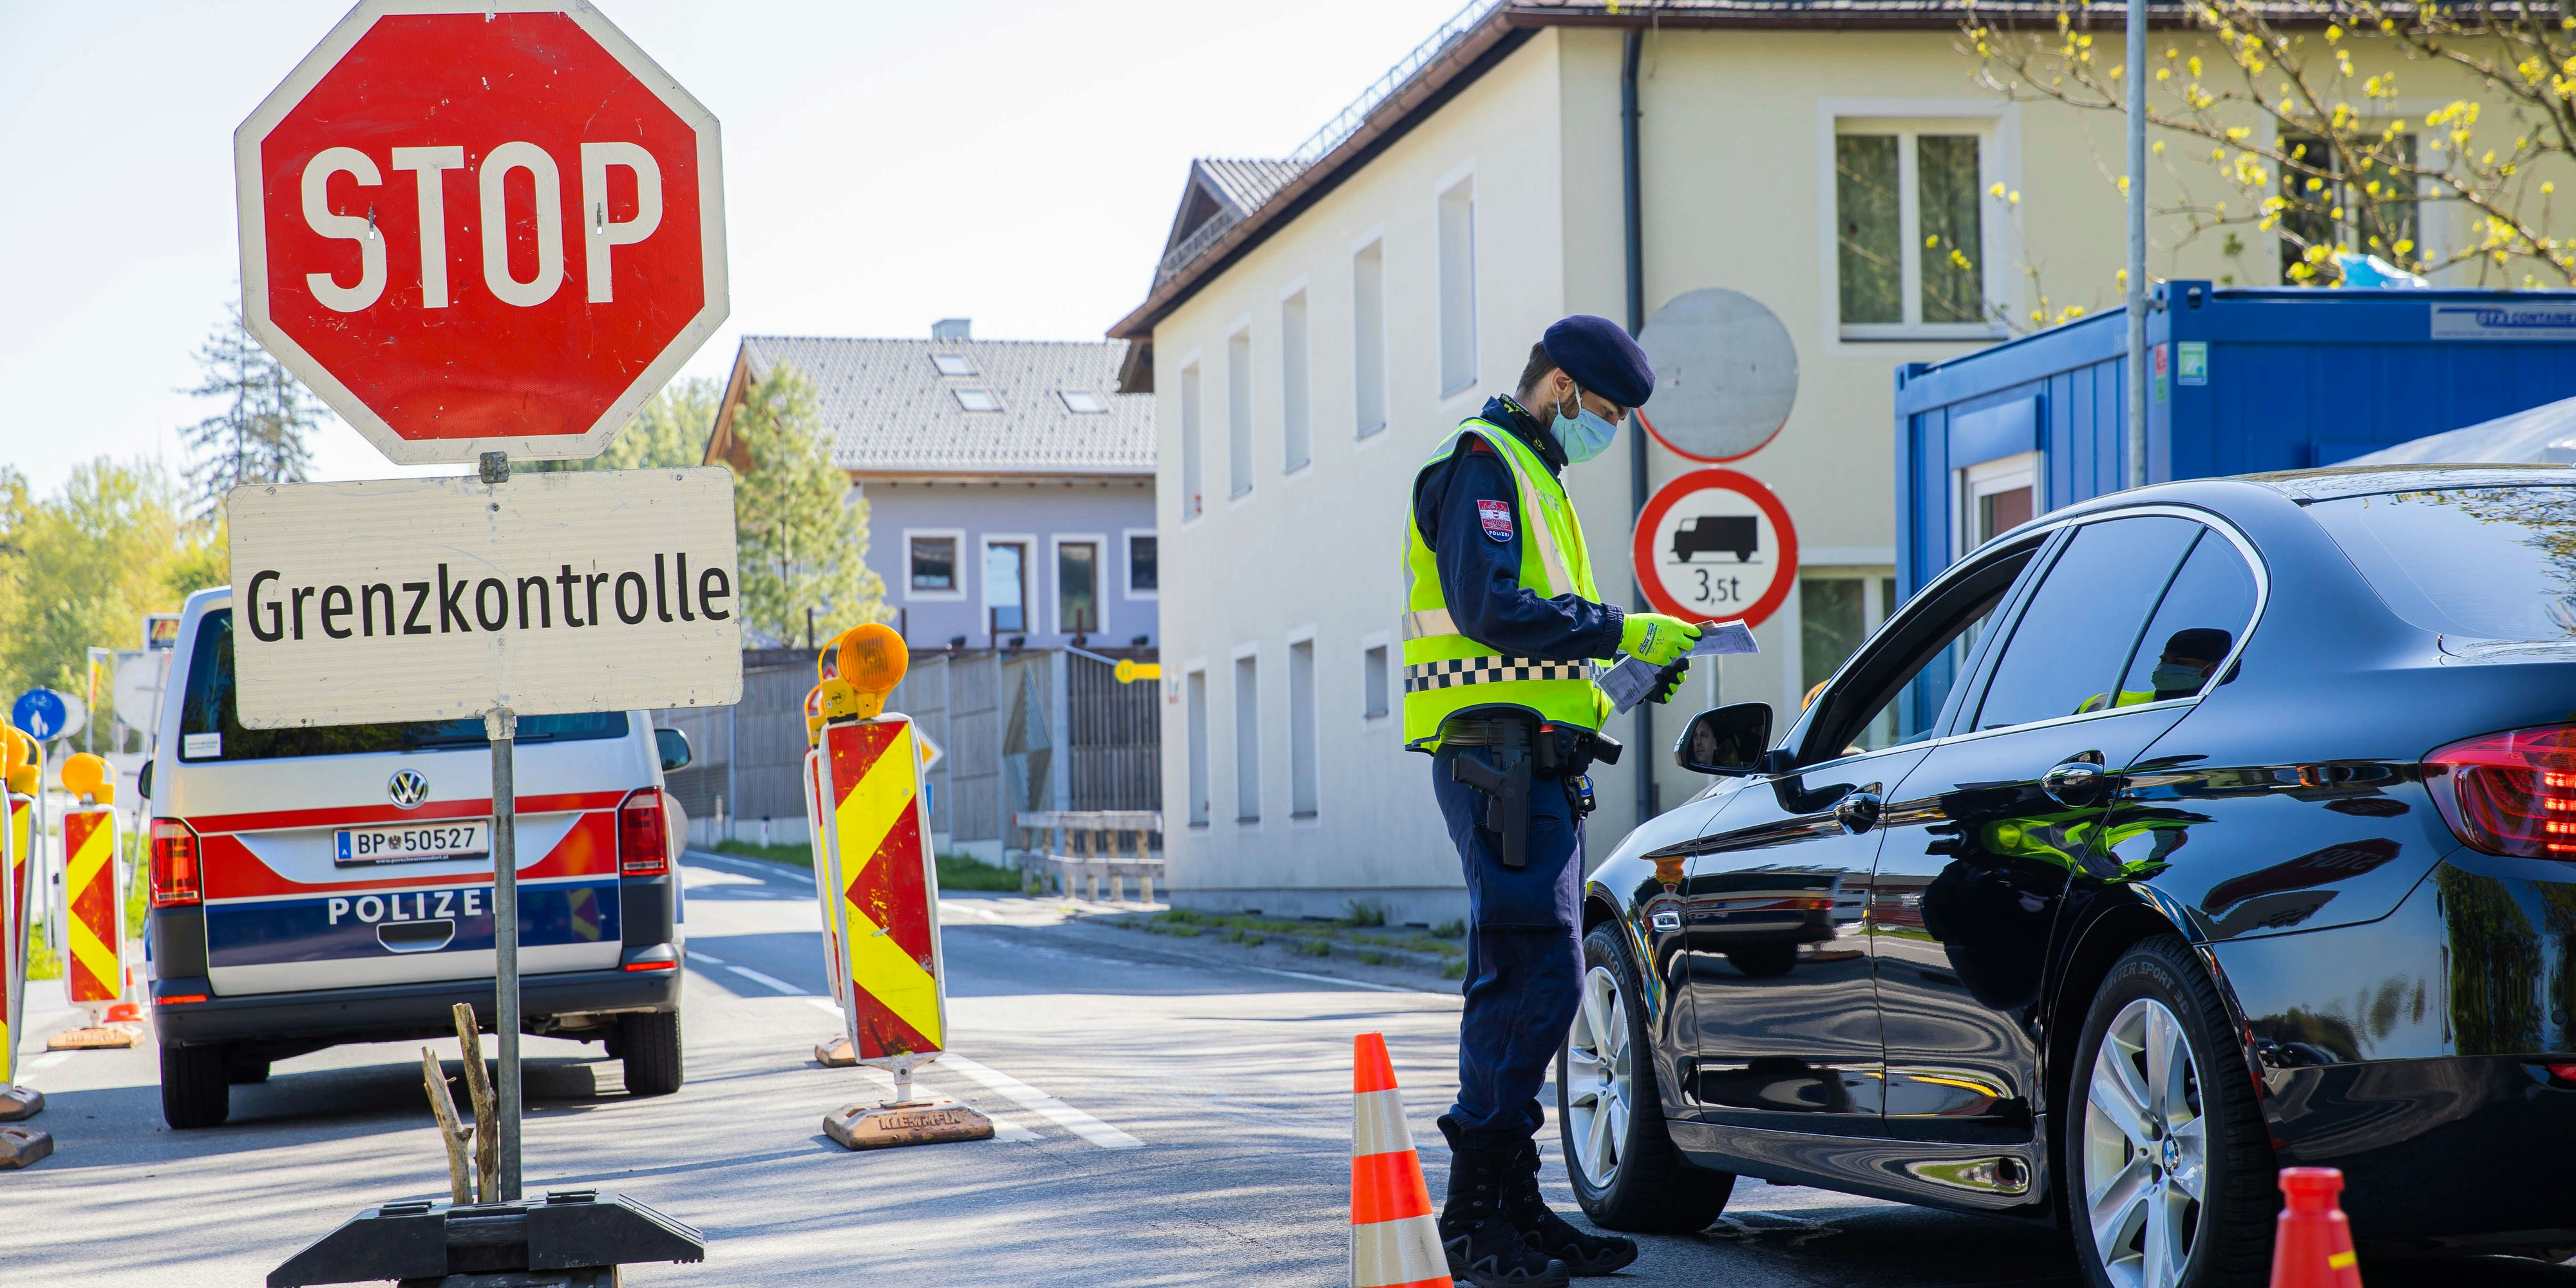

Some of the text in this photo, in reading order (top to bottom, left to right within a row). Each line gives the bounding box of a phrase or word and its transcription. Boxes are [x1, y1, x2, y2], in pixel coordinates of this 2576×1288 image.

[301, 141, 663, 312] STOP
[247, 553, 730, 642] Grenzkontrolle
[1695, 569, 1740, 605] 3,5t
[359, 828, 475, 854] BP 50527
[1591, 938, 1625, 985] DUNLOP
[2100, 961, 2137, 1000] WINTER
[2139, 961, 2175, 990] SPORT
[2174, 989, 2189, 1015] 3D
